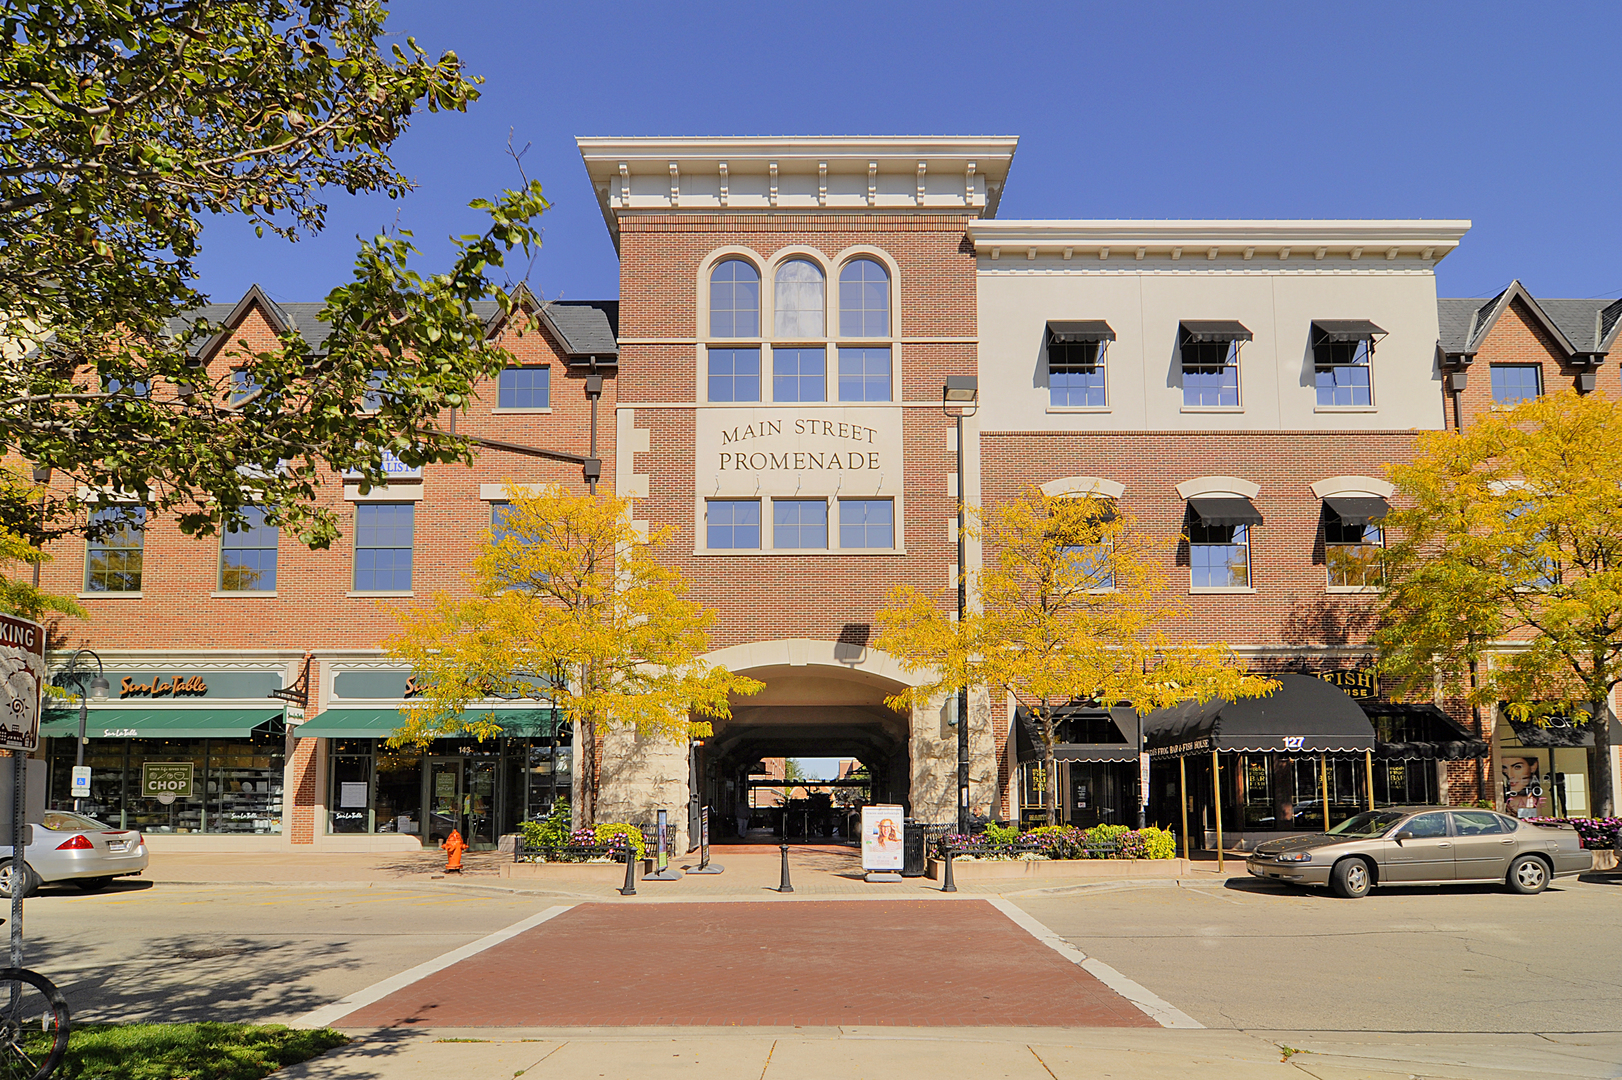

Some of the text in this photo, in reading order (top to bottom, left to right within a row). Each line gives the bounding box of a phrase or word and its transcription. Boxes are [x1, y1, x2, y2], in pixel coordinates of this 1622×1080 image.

[722, 419, 878, 445] MAIN STREET
[719, 452, 881, 470] PROMENADE
[119, 675, 207, 695] Sur La Table
[1322, 672, 1371, 688] FISH
[458, 746, 471, 754] 143
[1282, 737, 1305, 748] 127
[148, 780, 187, 790] CHOP
